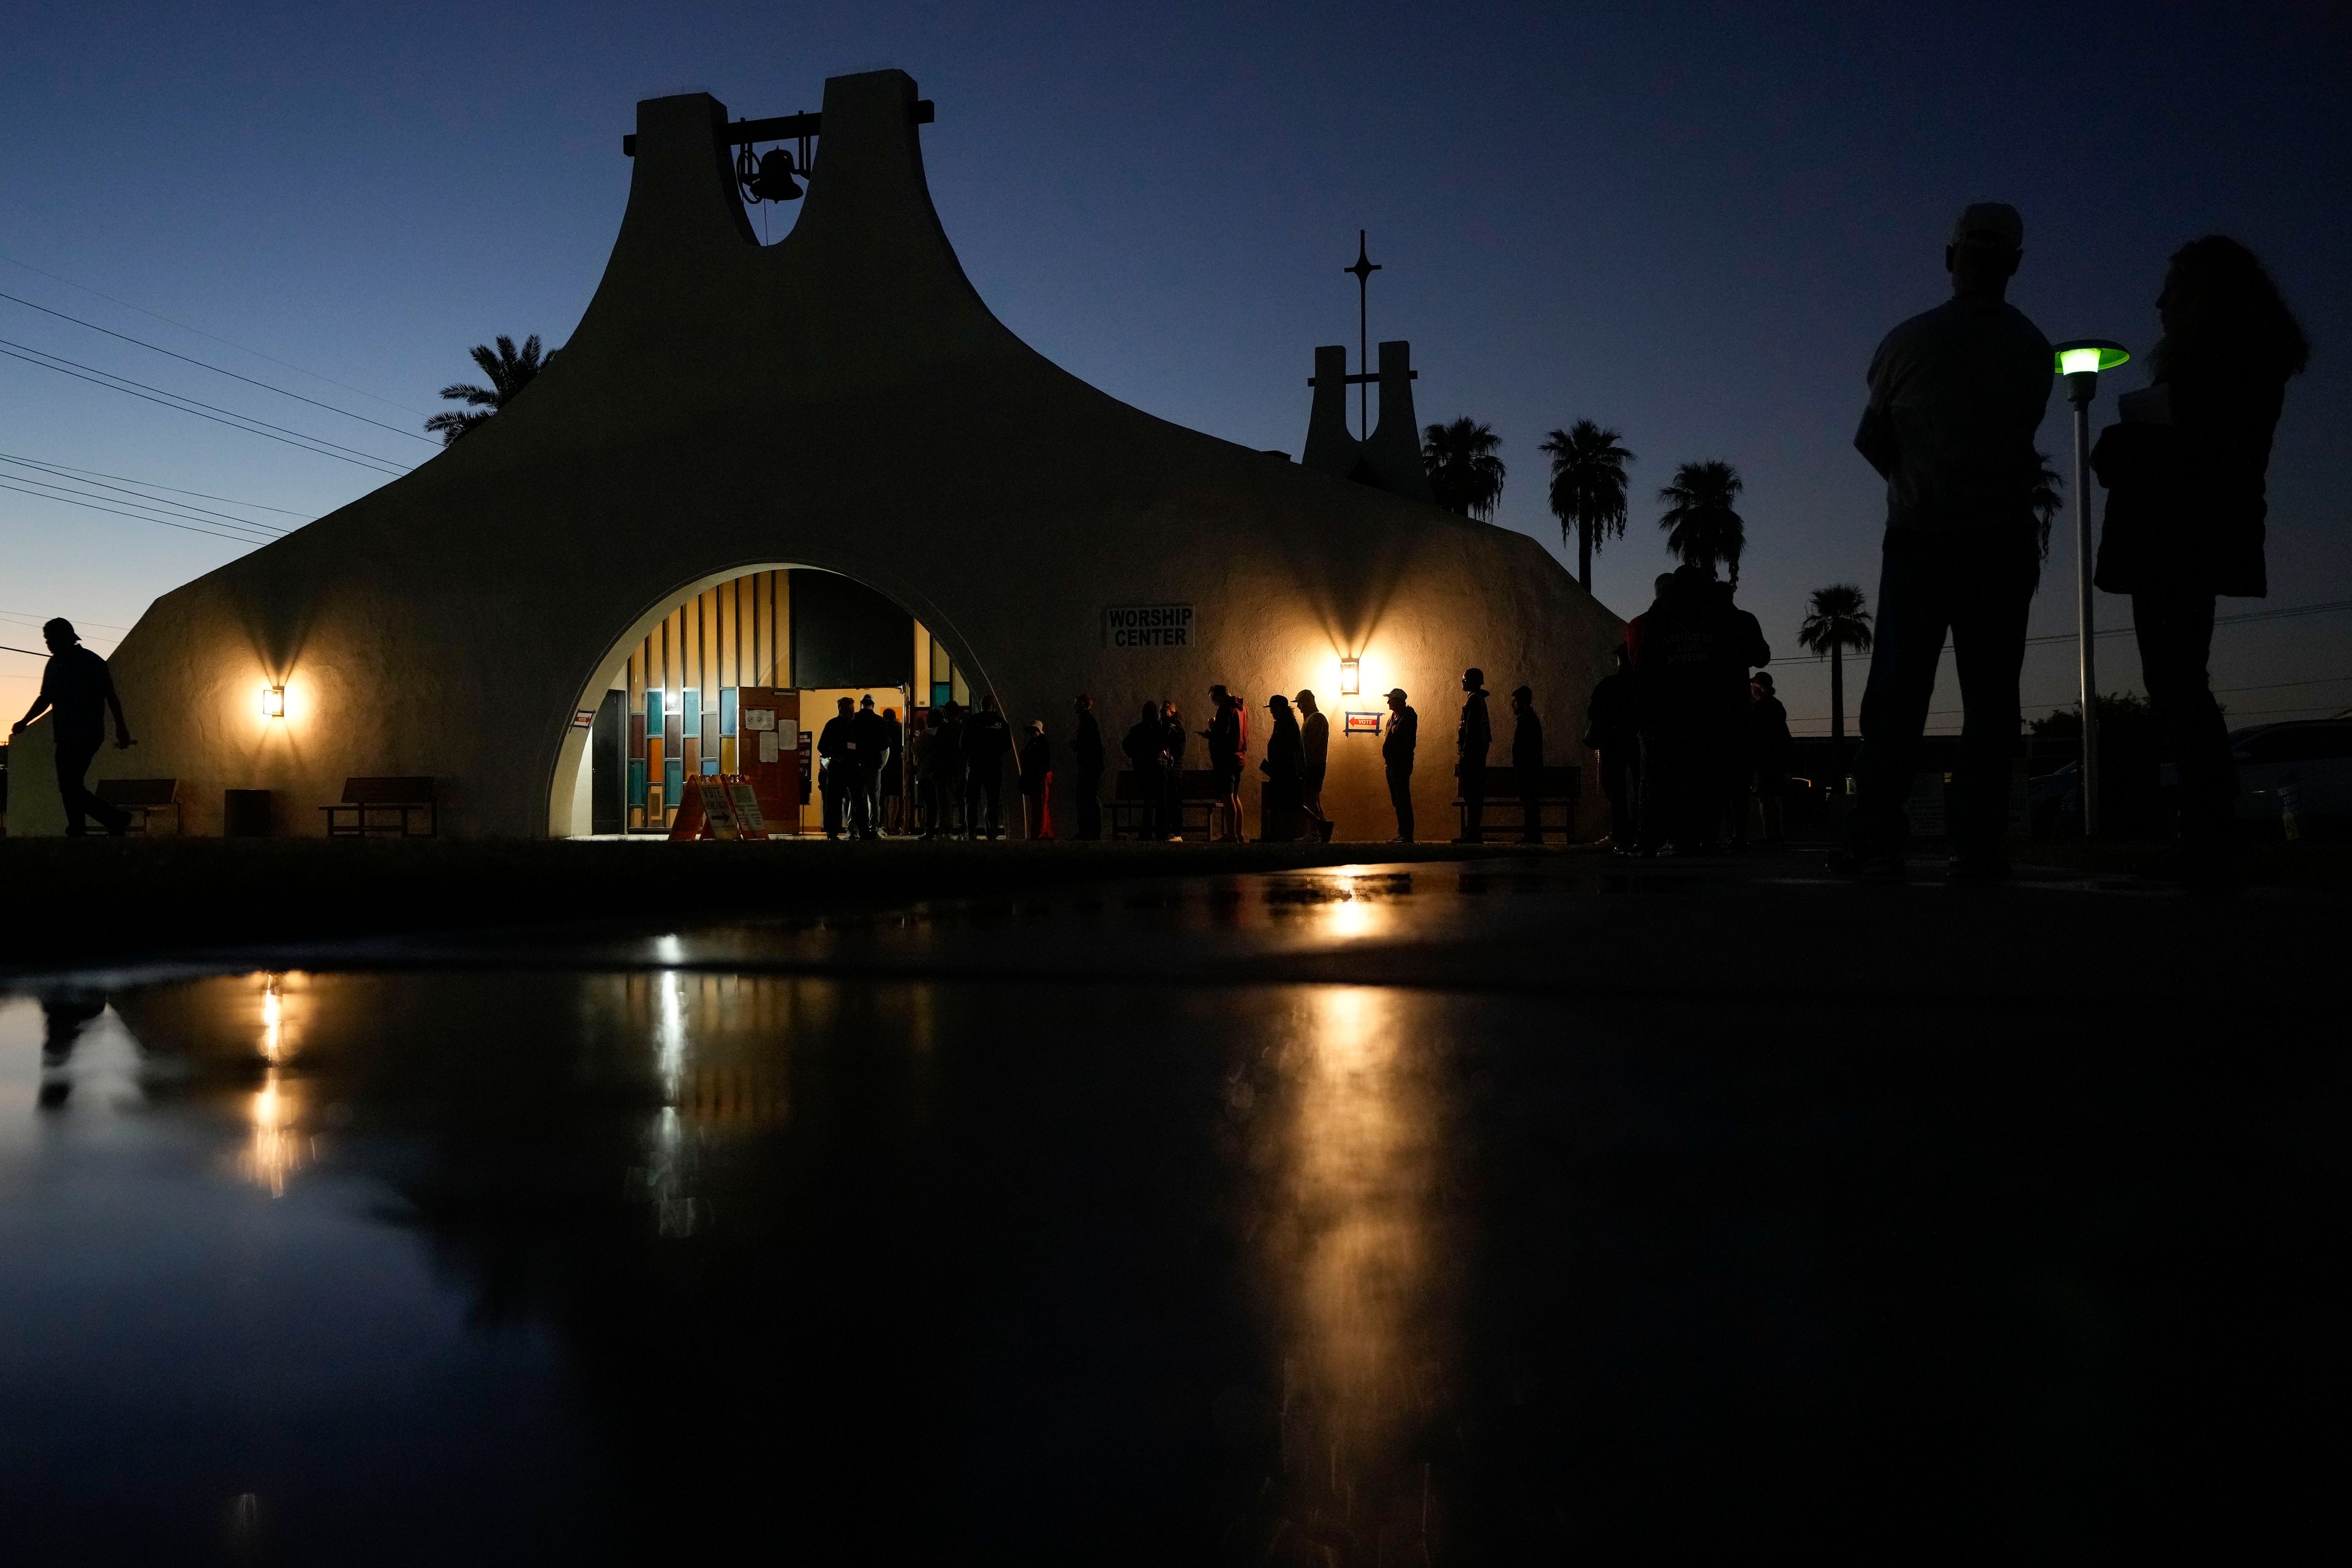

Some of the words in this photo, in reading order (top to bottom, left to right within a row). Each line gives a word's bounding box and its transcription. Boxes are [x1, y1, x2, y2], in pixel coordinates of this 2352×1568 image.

[1109, 608, 1192, 627] WORSHIP
[1115, 628, 1186, 647] CENTER
[701, 787, 723, 798] VOTE
